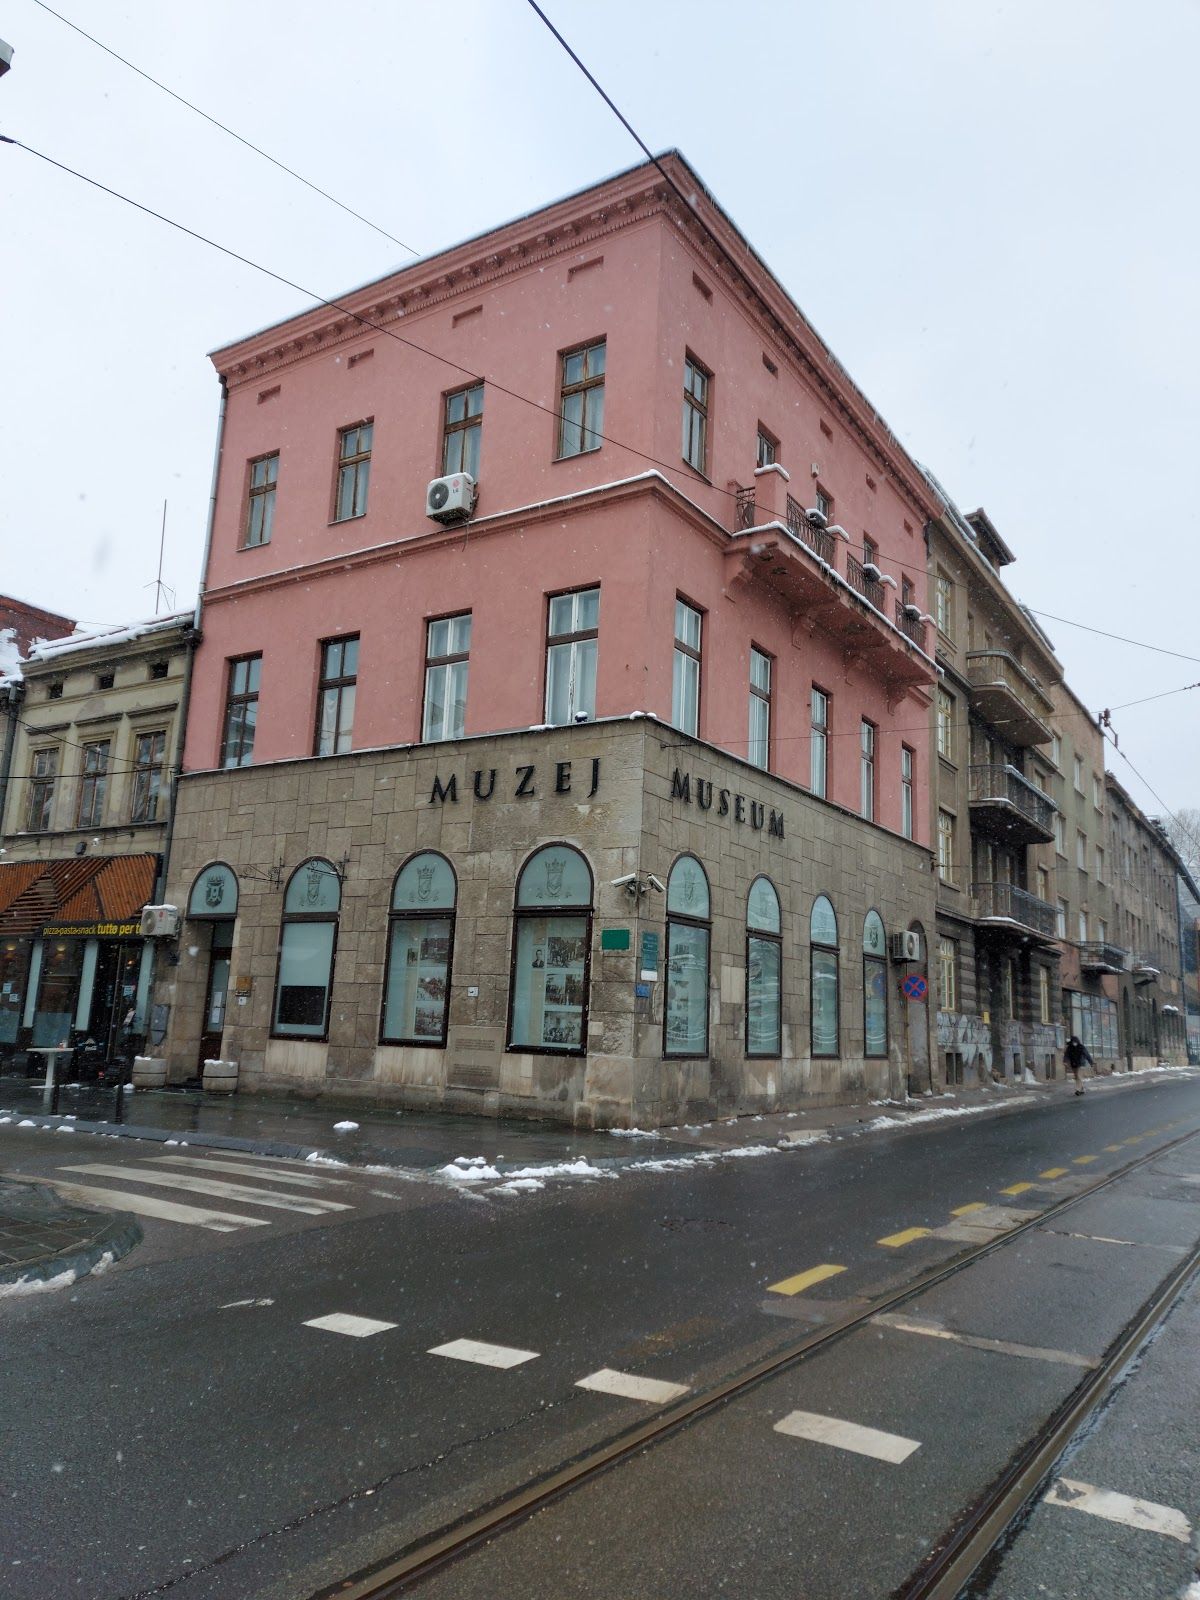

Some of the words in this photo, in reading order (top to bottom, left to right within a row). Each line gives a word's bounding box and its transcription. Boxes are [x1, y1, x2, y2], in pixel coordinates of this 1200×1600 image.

[428, 757, 601, 804] MUZEJ
[670, 767, 786, 840] MUSEUM
[97, 923, 118, 934] tutto
[119, 924, 135, 936] per
